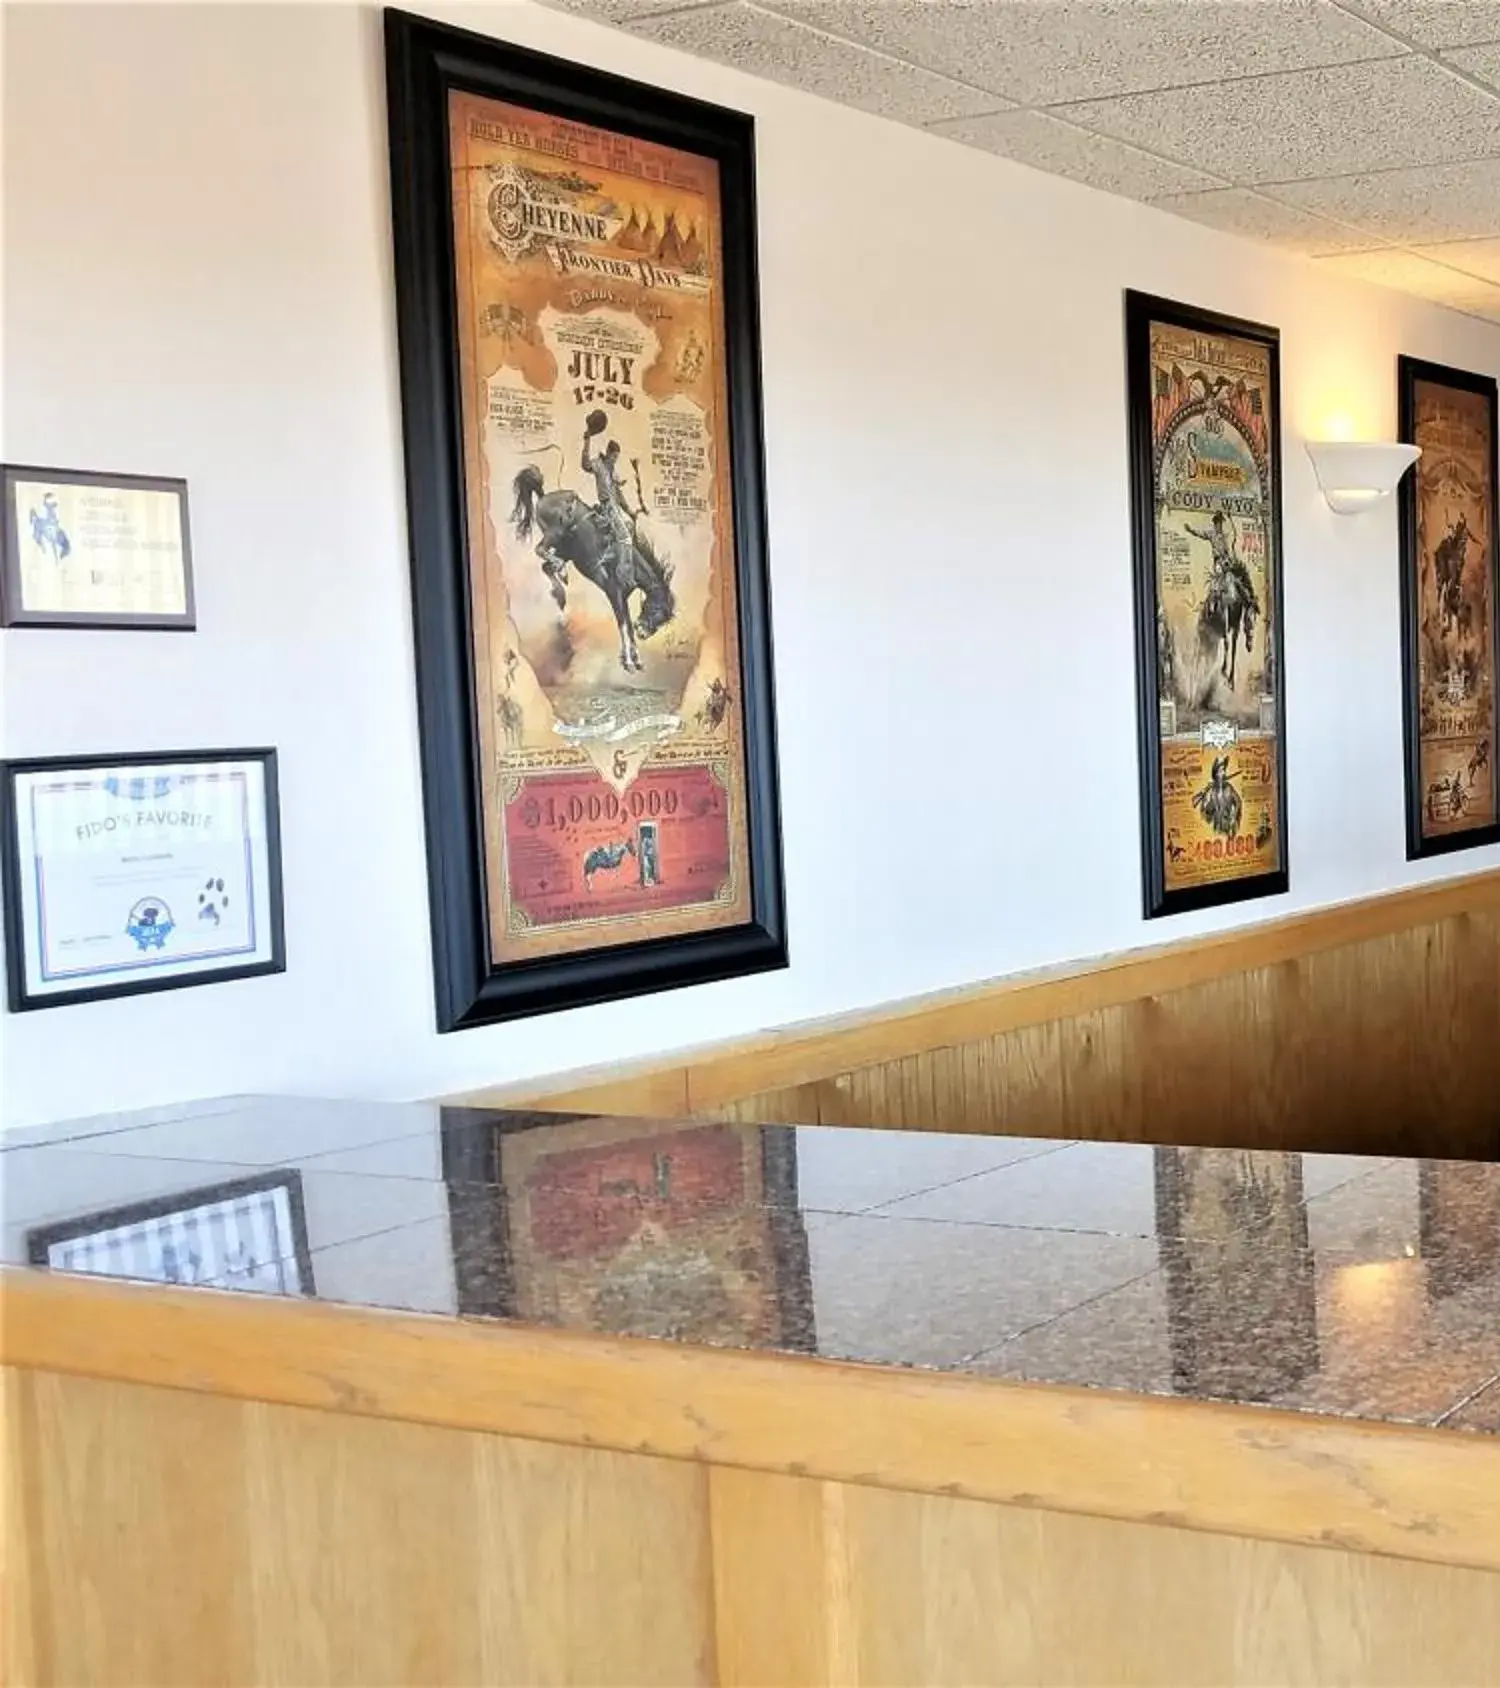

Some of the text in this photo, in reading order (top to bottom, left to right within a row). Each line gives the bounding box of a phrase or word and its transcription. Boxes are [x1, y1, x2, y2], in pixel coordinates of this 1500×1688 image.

[488, 180, 608, 241] CHEYENNE
[549, 244, 681, 288] FRONTIER DAYS
[567, 349, 635, 385] JULY
[573, 385, 635, 410] 17-26
[1172, 490, 1213, 509] CODY
[523, 789, 678, 828] $1,000,000
